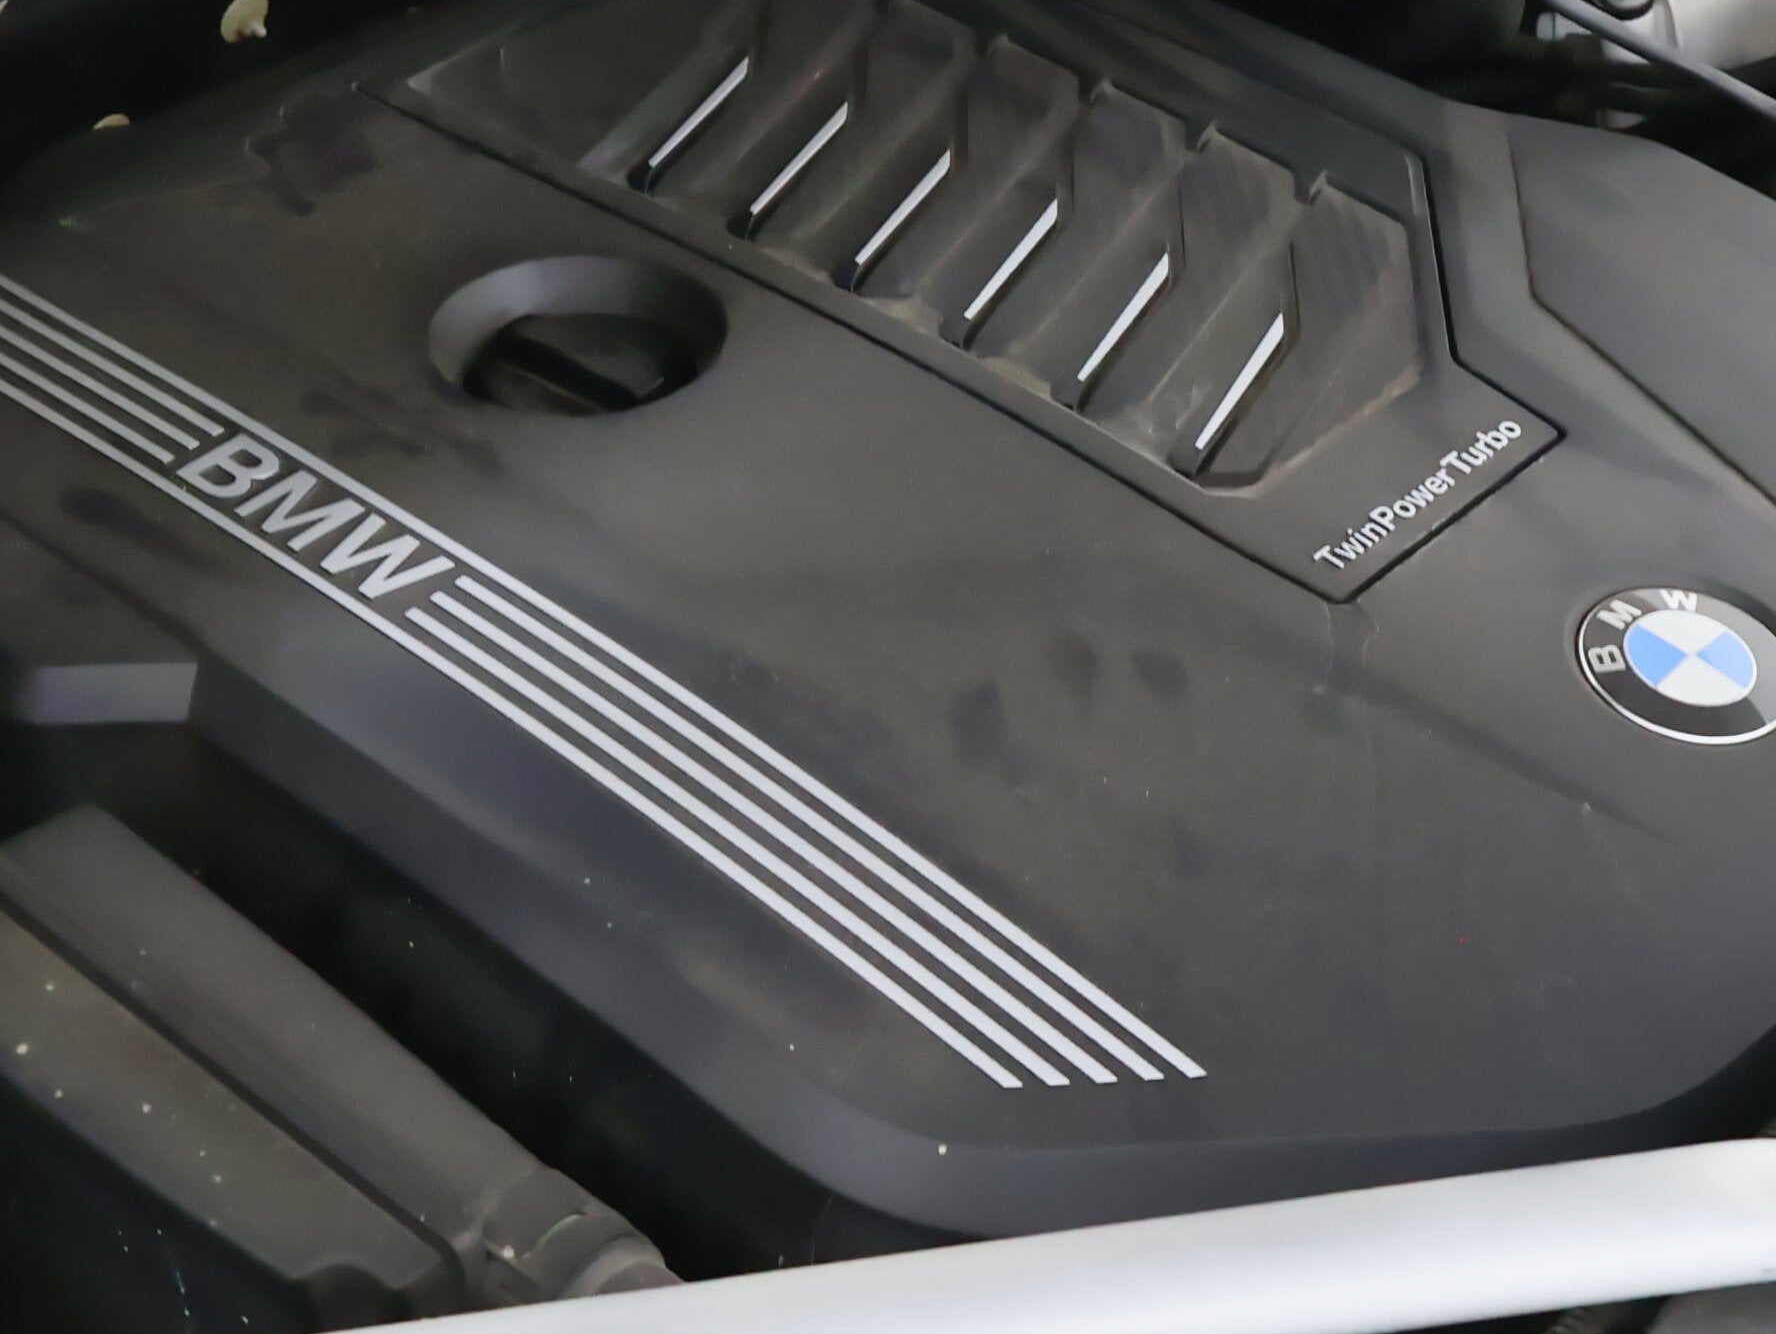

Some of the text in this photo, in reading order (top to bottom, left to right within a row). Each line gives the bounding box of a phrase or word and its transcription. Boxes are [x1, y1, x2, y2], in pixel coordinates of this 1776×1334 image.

[175, 432, 456, 599] BMW
[1313, 417, 1523, 571] TwinPowerTurbo
[1587, 588, 1699, 674] BMW
